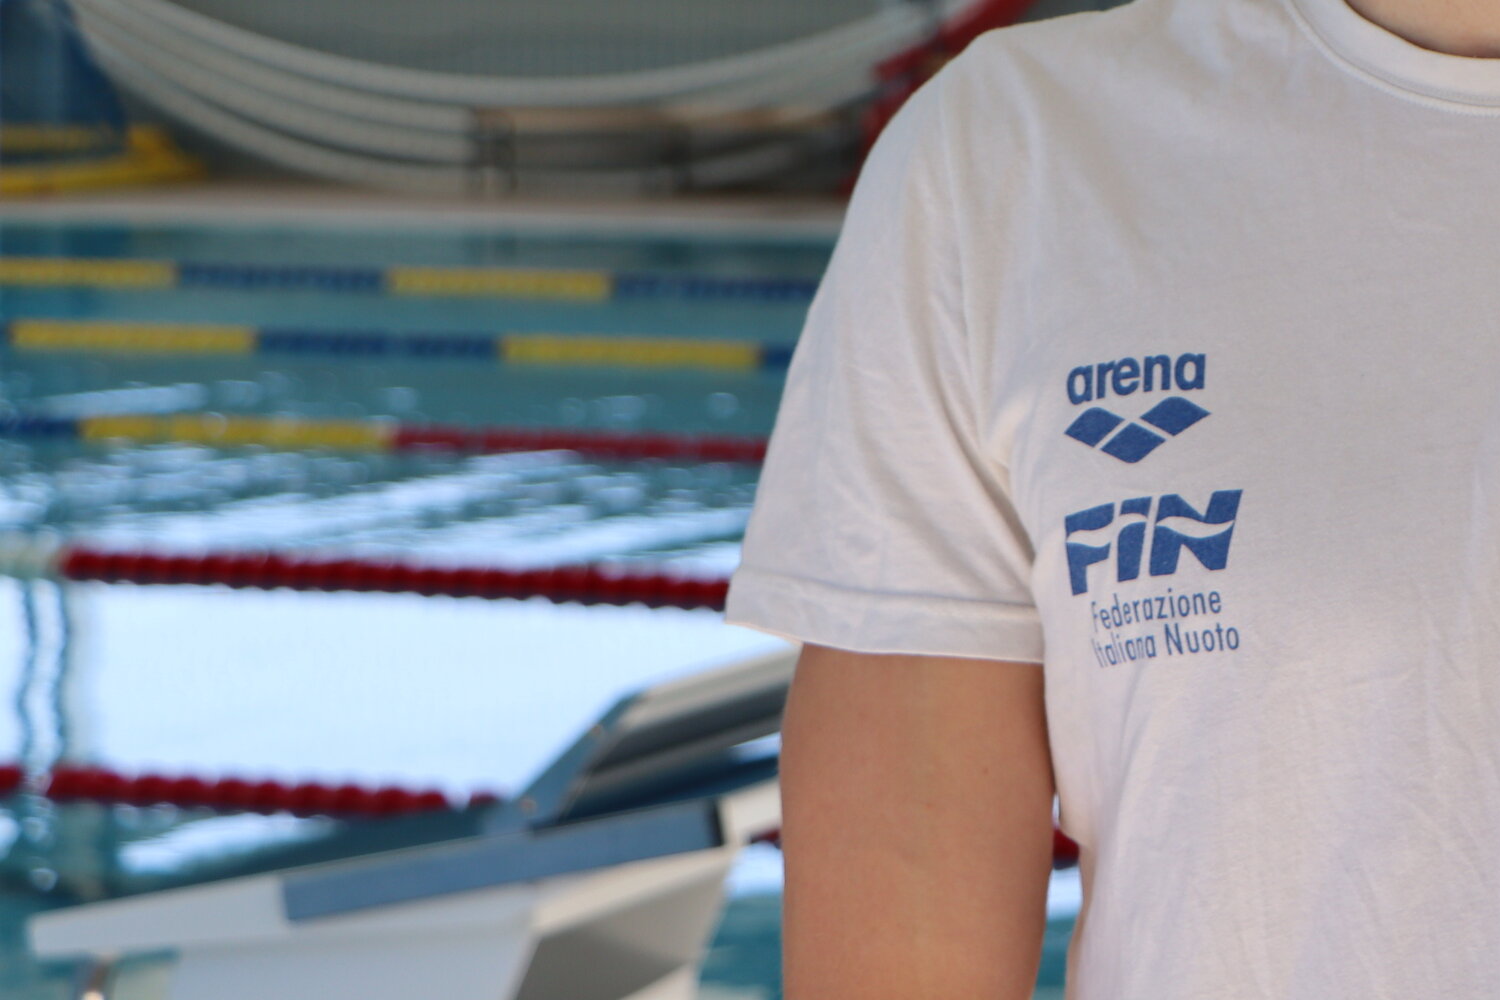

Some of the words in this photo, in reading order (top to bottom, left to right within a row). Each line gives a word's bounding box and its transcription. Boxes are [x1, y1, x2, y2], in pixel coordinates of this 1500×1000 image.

[1066, 352, 1207, 406] arena
[1064, 489, 1244, 597] FIN
[1090, 588, 1223, 634] Federazione
[1164, 624, 1241, 658] Nuoto
